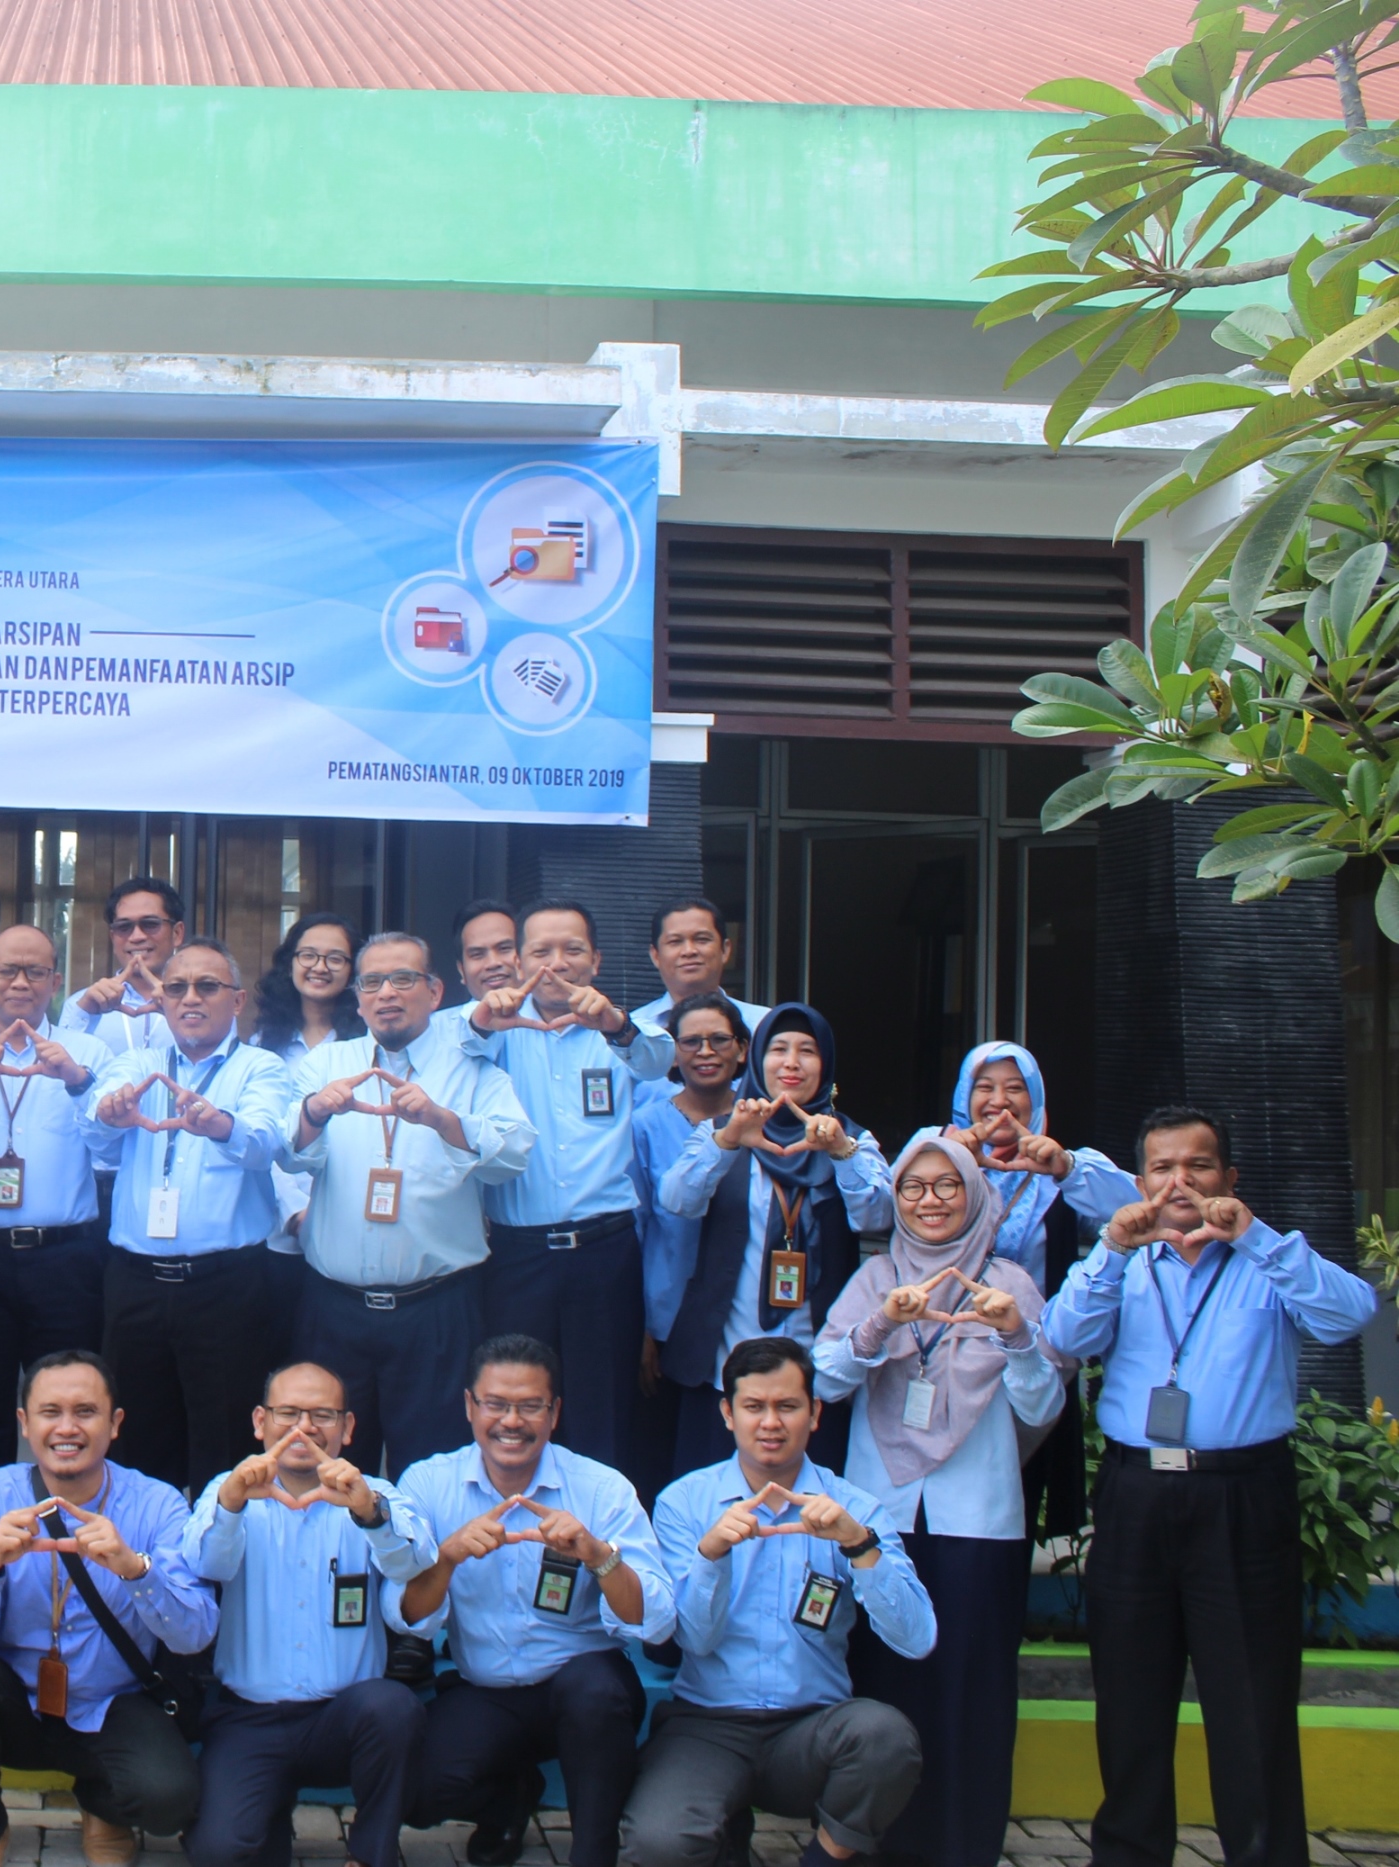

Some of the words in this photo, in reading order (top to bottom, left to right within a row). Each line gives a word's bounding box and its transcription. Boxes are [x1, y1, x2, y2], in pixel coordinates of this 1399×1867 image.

[29, 570, 80, 590] UTARA
[231, 660, 296, 687] ARSIP
[328, 760, 485, 786] PEMATANGSIANTAR,
[488, 765, 509, 785] 09
[512, 766, 584, 787] OKTOBER
[588, 768, 626, 788] 2019
